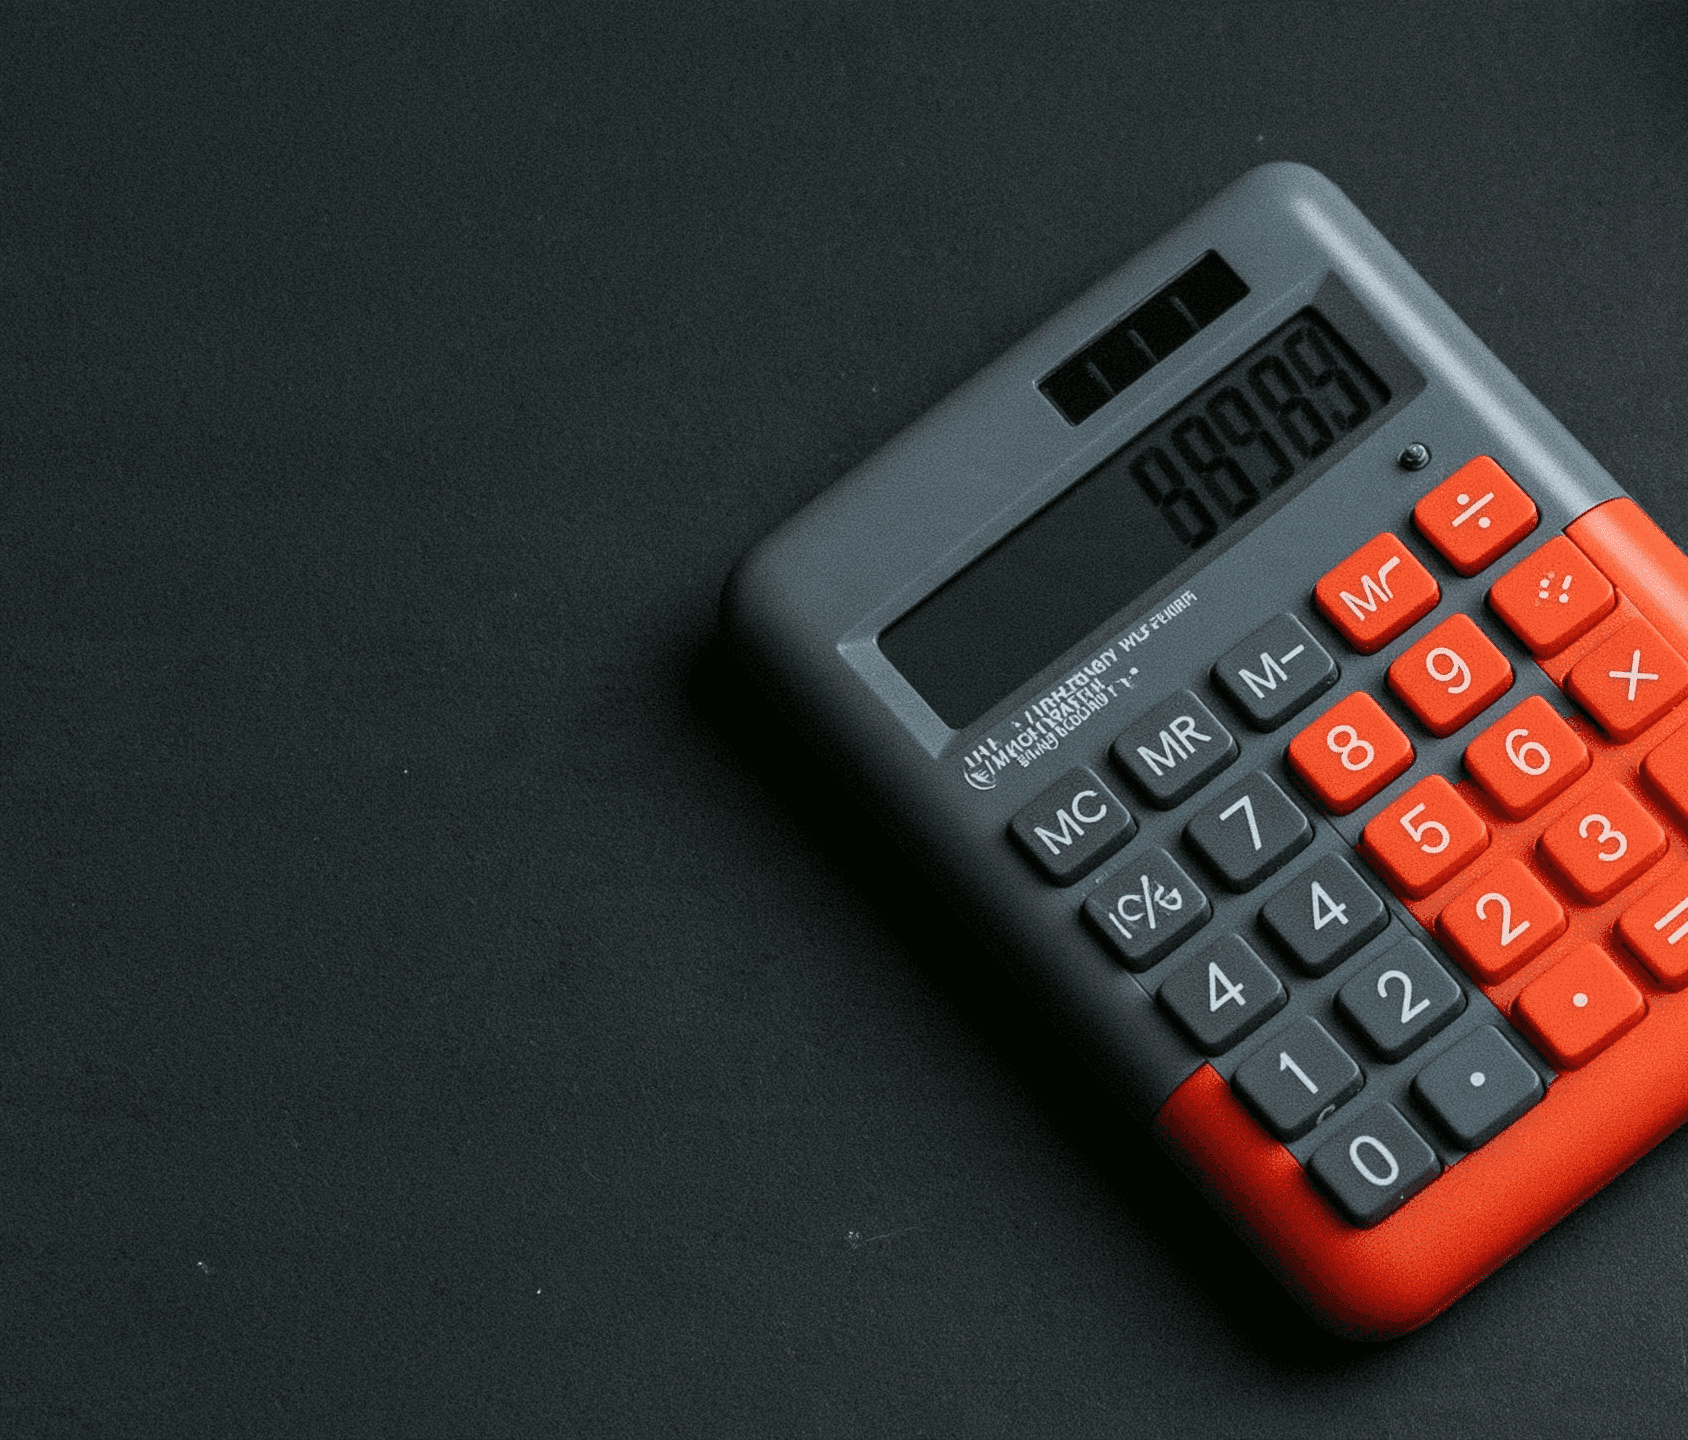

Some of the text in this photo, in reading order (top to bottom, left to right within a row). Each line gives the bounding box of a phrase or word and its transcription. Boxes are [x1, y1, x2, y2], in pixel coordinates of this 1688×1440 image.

[1425, 647, 1472, 694] 9
[1136, 715, 1212, 776] MR
[1326, 724, 1375, 771] 8
[1505, 728, 1551, 776] 6
[1034, 790, 1107, 855] MC
[1219, 795, 1262, 851] 7
[1399, 802, 1451, 854] 5
[1578, 813, 1628, 862] 3
[1311, 881, 1349, 930] 4
[1475, 892, 1531, 946] 2
[1208, 962, 1246, 1012] 4
[1377, 970, 1431, 1024] 2
[1279, 1051, 1319, 1094] 1
[1349, 1135, 1399, 1186] 0
